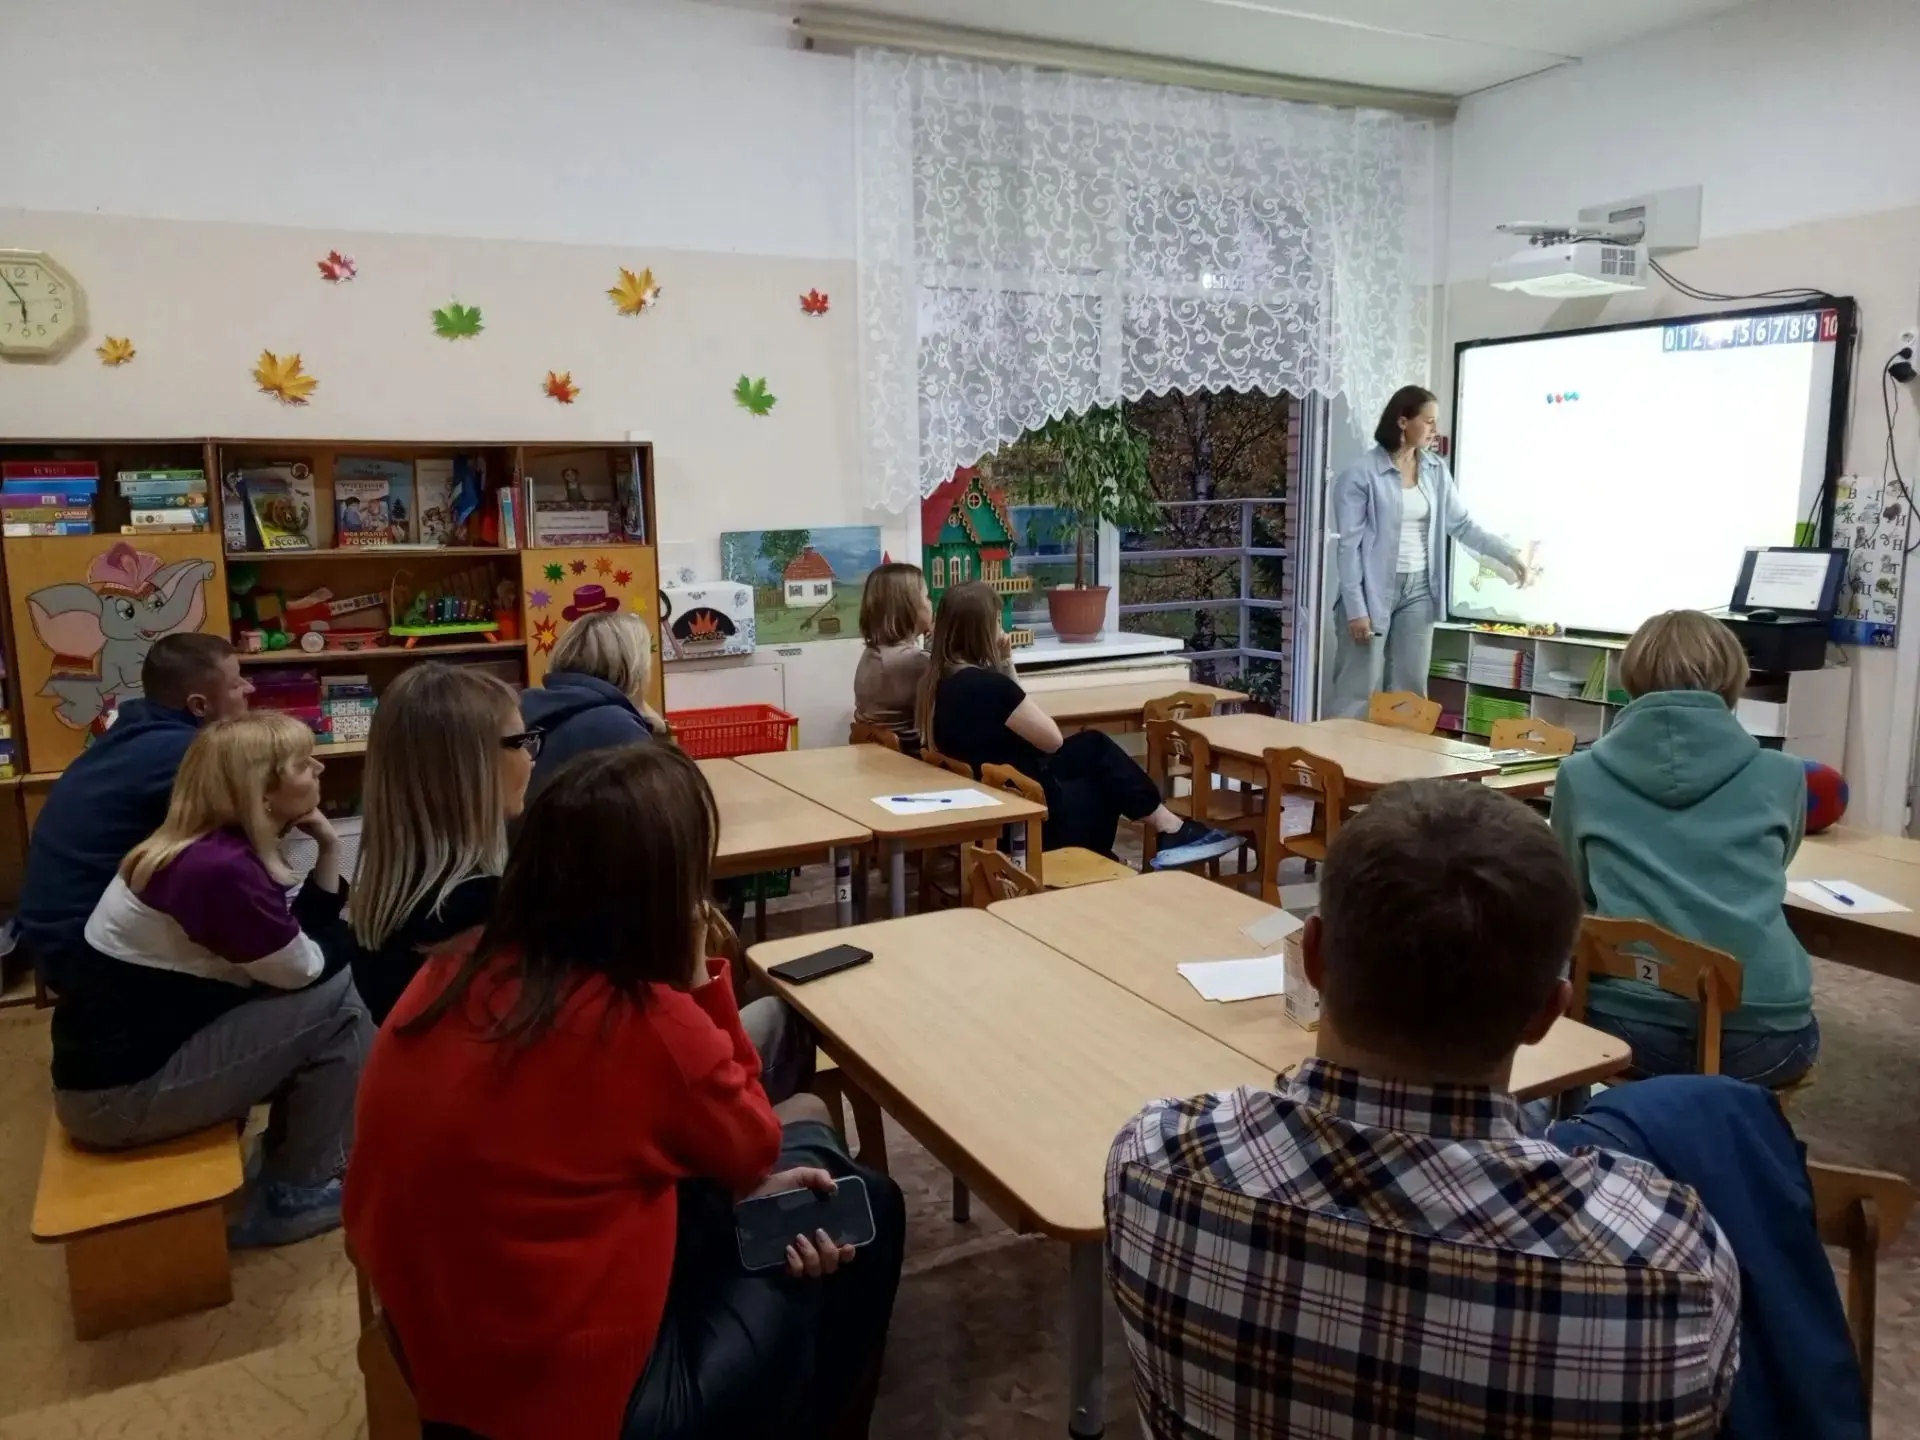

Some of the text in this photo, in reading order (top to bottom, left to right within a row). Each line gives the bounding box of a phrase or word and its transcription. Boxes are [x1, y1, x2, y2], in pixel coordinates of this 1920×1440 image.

[48, 283, 57, 295] 2
[54, 297, 63, 310] 3
[51, 313, 59, 324] 4
[36, 324, 47, 336] 5
[1680, 327, 1688, 348] 1
[1739, 320, 1750, 343] 5
[1756, 320, 1767, 342] 6
[1773, 317, 1785, 342] 7
[1789, 317, 1800, 340] 8
[1806, 315, 1818, 339] 9
[1823, 314, 1838, 337] 10
[1842, 512, 1855, 524] Ж
[1896, 514, 1906, 526] И
[1863, 539, 1876, 550] М
[1892, 539, 1904, 551] Н
[1863, 561, 1900, 575] С Т
[1861, 583, 1872, 598] Ц
[1857, 608, 1869, 620] Ы
[1885, 612, 1896, 623] Э
[839, 888, 847, 900] 2
[1642, 965, 1652, 980] 2
